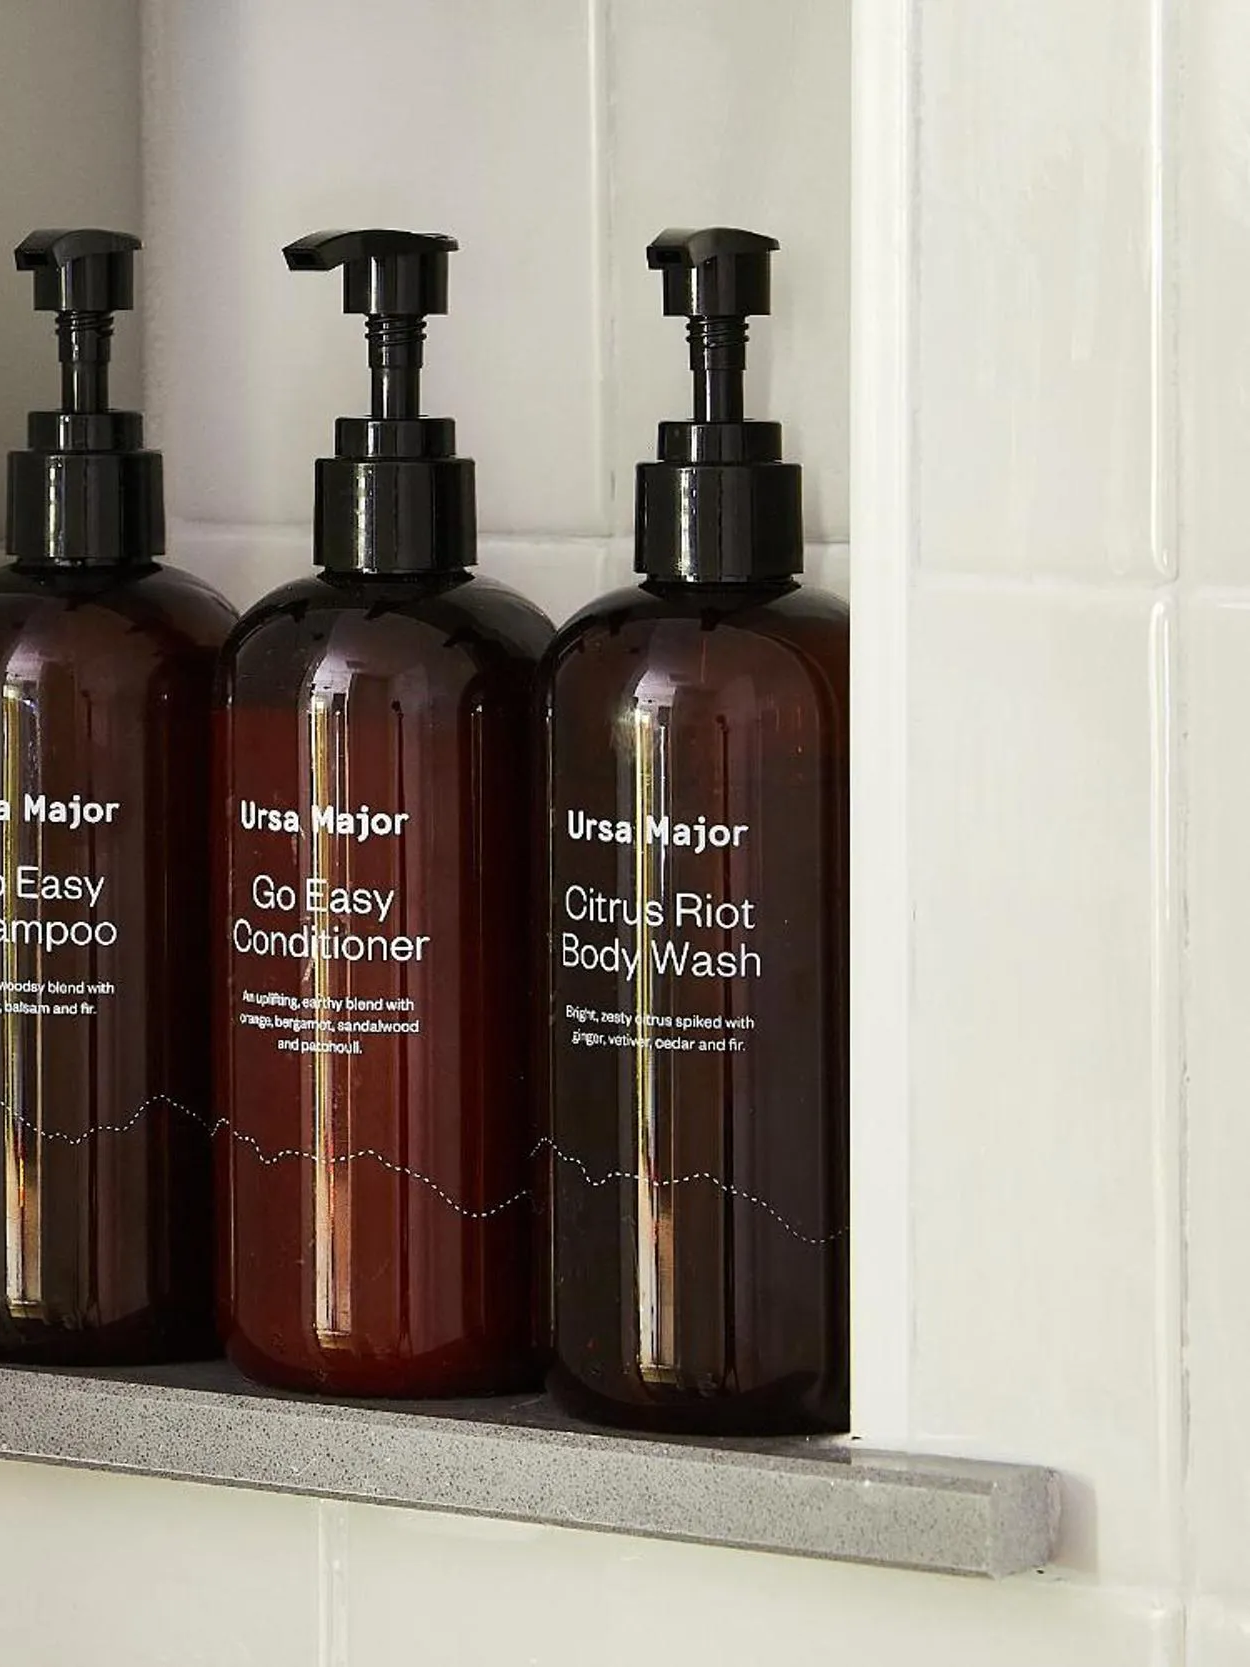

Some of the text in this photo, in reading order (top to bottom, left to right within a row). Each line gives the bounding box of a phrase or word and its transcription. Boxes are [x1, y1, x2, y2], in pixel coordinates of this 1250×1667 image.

[24, 793, 120, 829] Major
[240, 800, 409, 842] Ursa Major
[567, 810, 749, 854] Ursa Major
[16, 865, 105, 908] Easy
[253, 875, 395, 922] Go Easy
[565, 885, 756, 929] Citrus Riot
[233, 918, 430, 961] Conditioner
[562, 932, 761, 981] Body Wash
[48, 980, 85, 994] blend
[86, 981, 115, 995] with
[256, 992, 300, 1010] uplifting,
[301, 996, 343, 1012] earthy
[345, 998, 383, 1011] blend
[385, 998, 414, 1011] with
[4, 1001, 50, 1014] balsam
[53, 1002, 78, 1015] and
[80, 1001, 97, 1015] fir.
[239, 1013, 420, 1033] orange, bergamot, sandalwood
[565, 1004, 599, 1023] Bright,
[601, 1011, 632, 1026] zesty
[675, 1015, 722, 1030] spiked
[725, 1016, 755, 1029] with
[277, 1038, 299, 1051] and
[571, 1028, 746, 1051] ginger, vetiver, cedar and fir.
